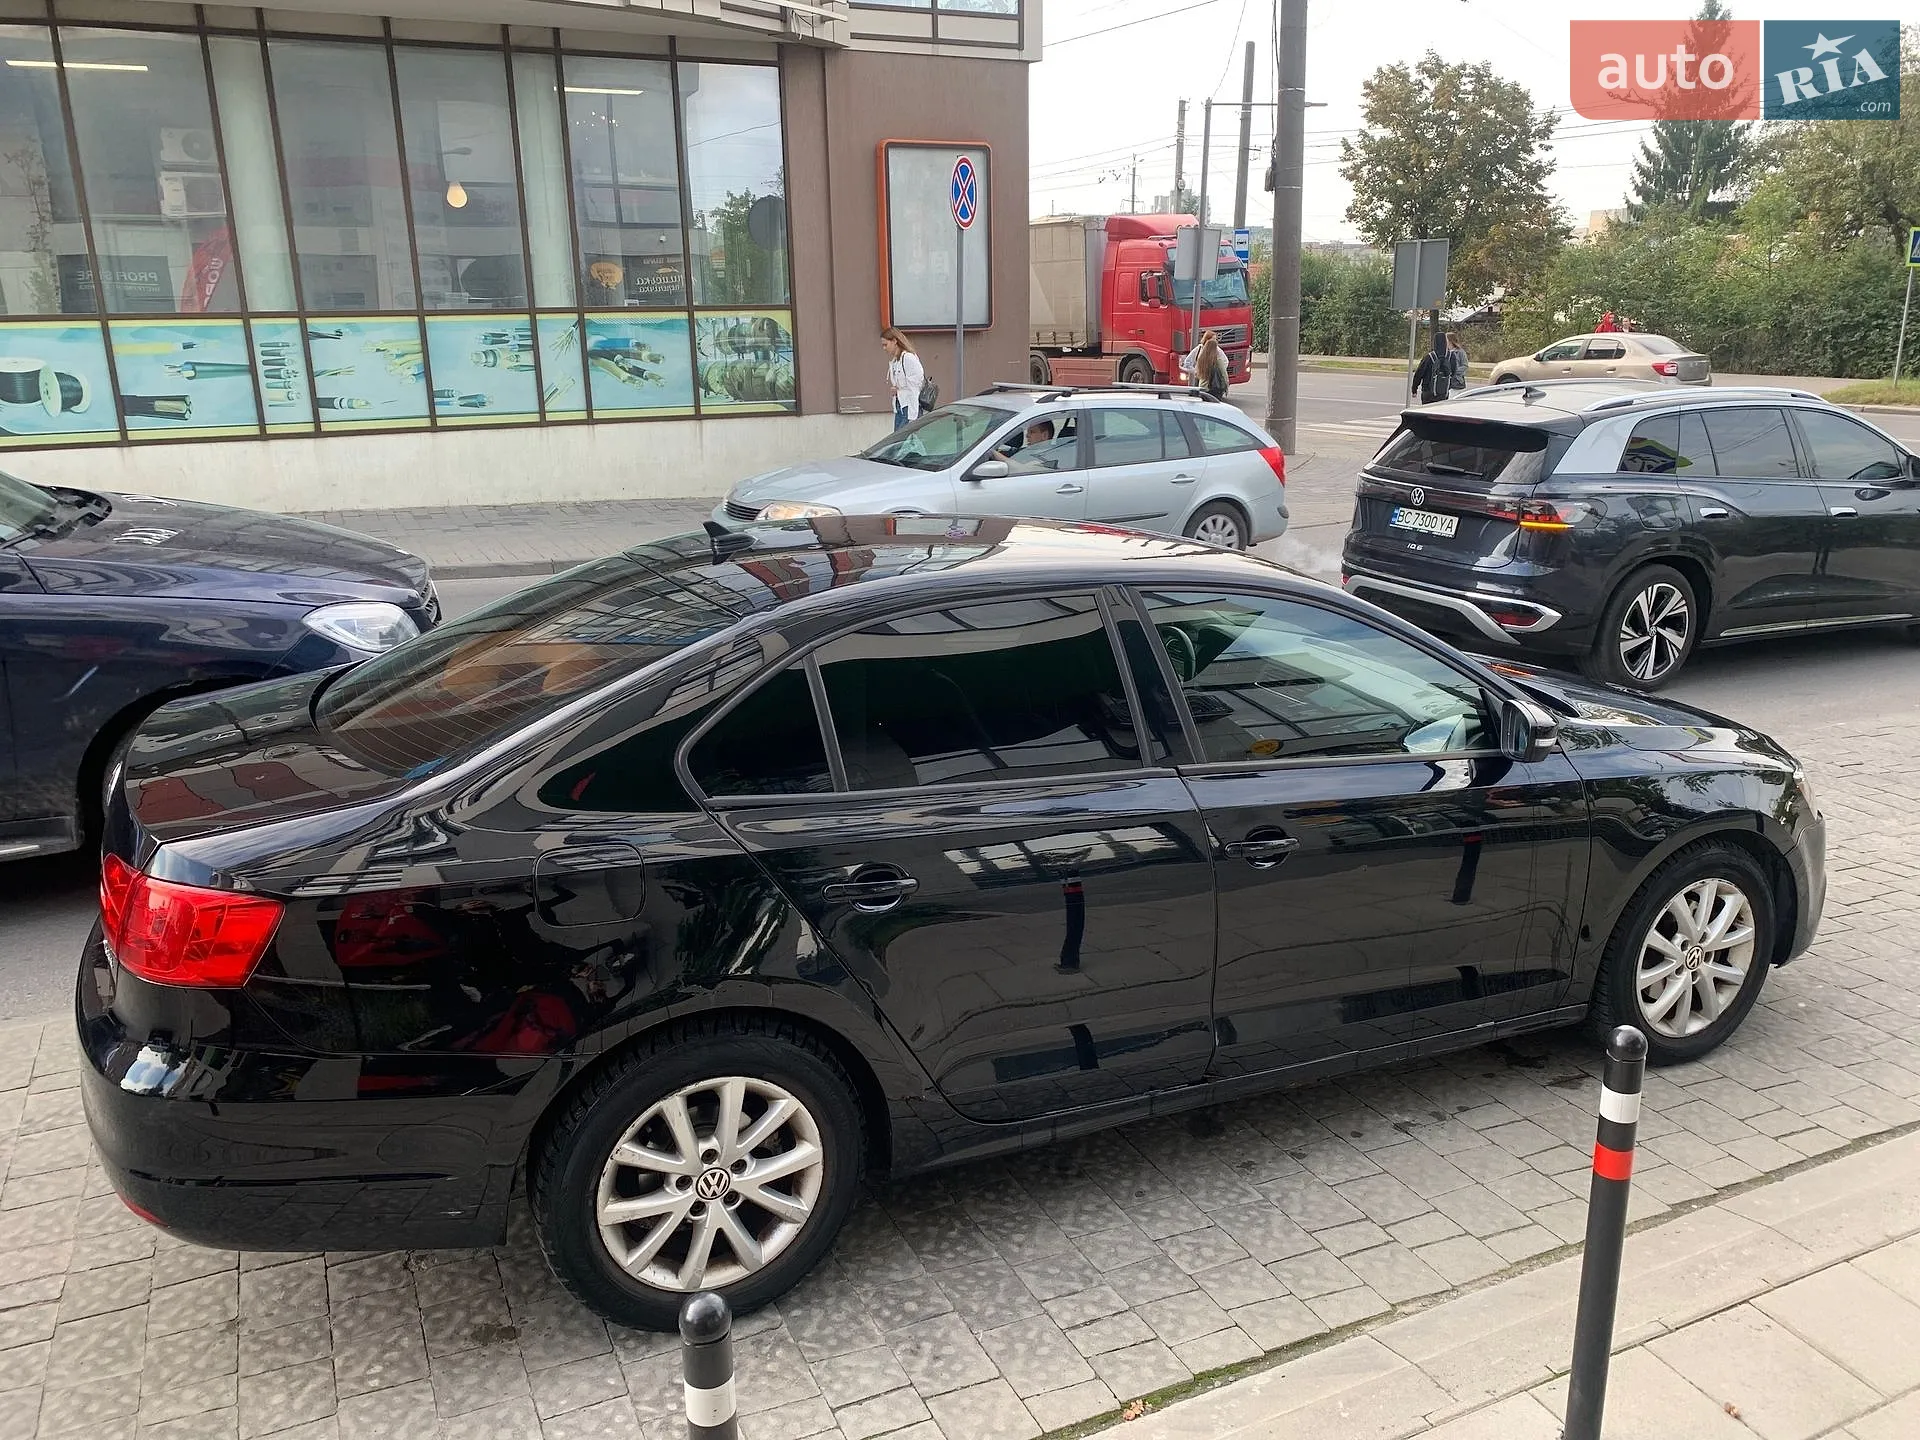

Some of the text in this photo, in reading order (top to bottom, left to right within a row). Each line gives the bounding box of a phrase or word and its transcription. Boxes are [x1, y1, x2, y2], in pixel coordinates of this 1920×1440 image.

[1396, 509, 1412, 525] BC
[1412, 512, 1438, 529] 7300
[1439, 517, 1454, 533] YA
